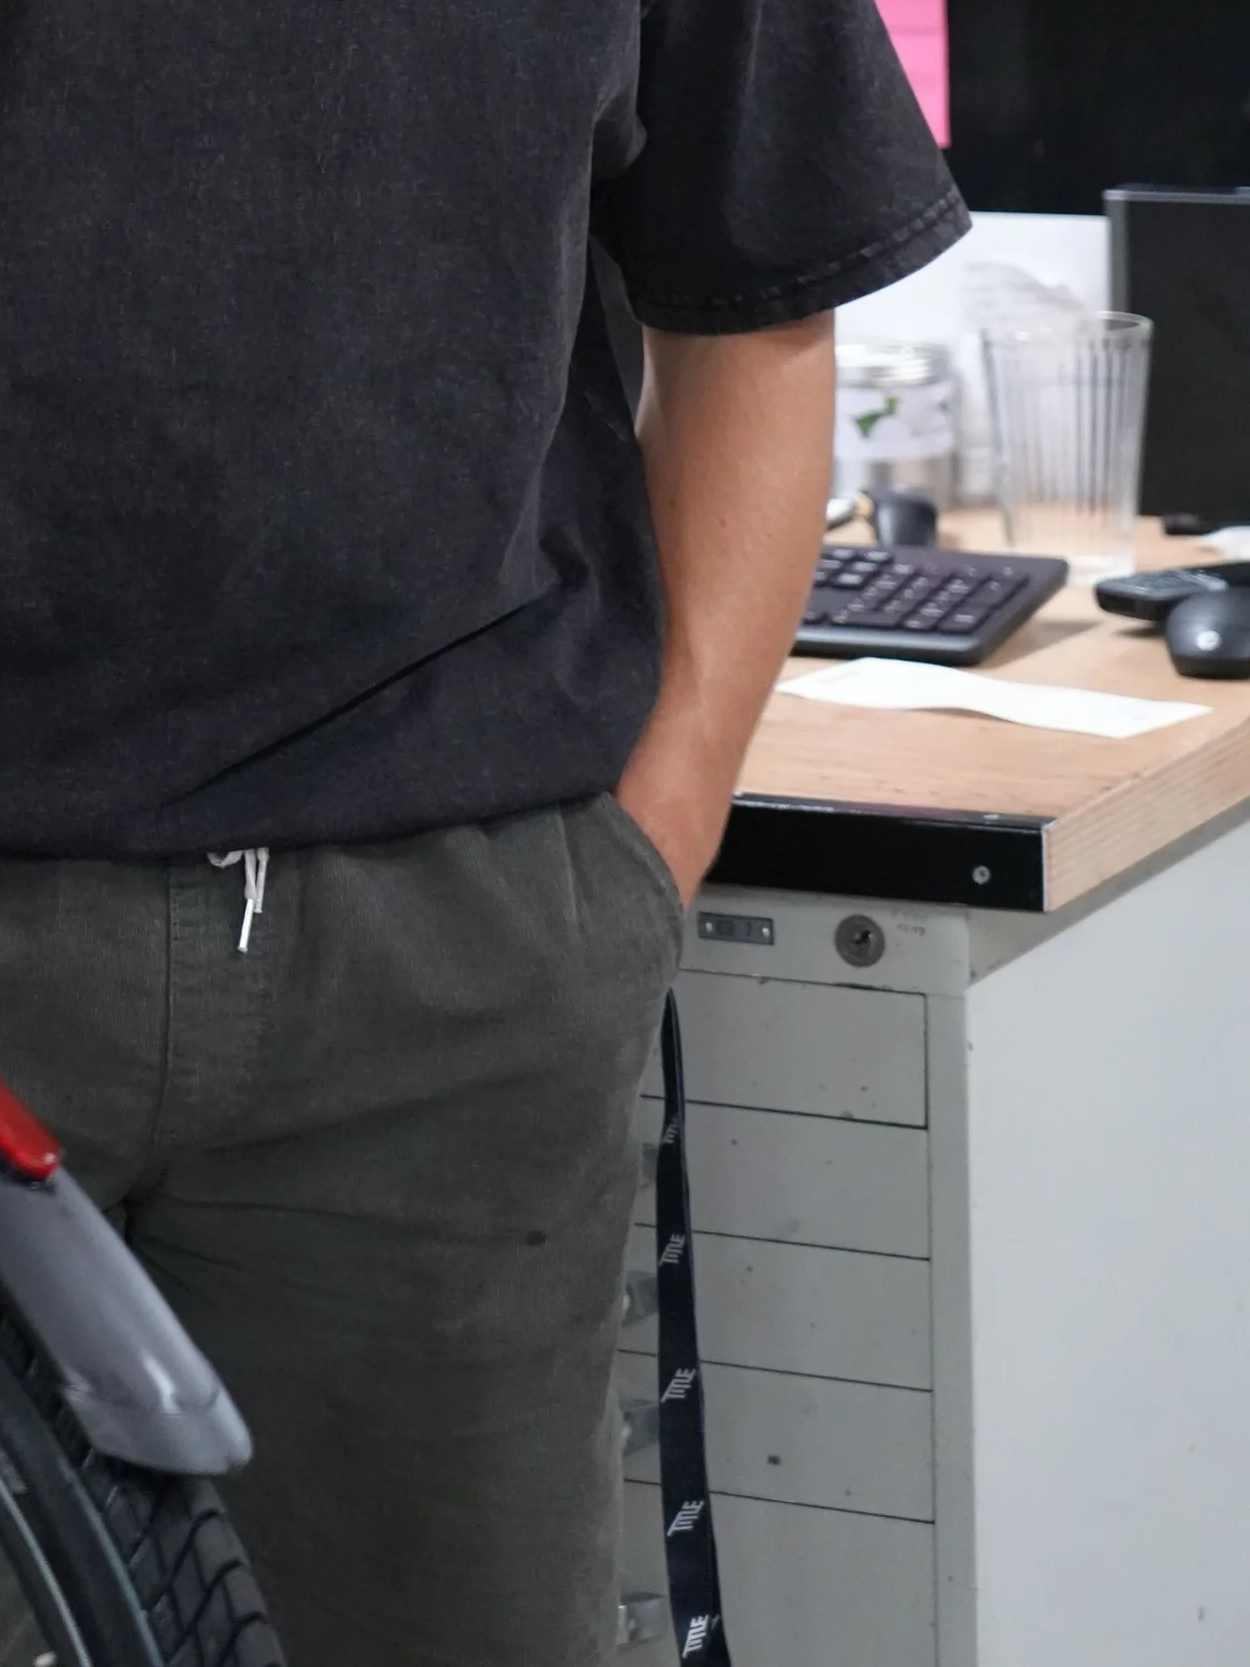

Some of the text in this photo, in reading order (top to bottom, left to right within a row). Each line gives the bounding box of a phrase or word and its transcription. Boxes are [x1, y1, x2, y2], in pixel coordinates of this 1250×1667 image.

[661, 1368, 696, 1402] TITLE
[667, 1500, 704, 1536] TITLE
[682, 1615, 710, 1659] TITLE
